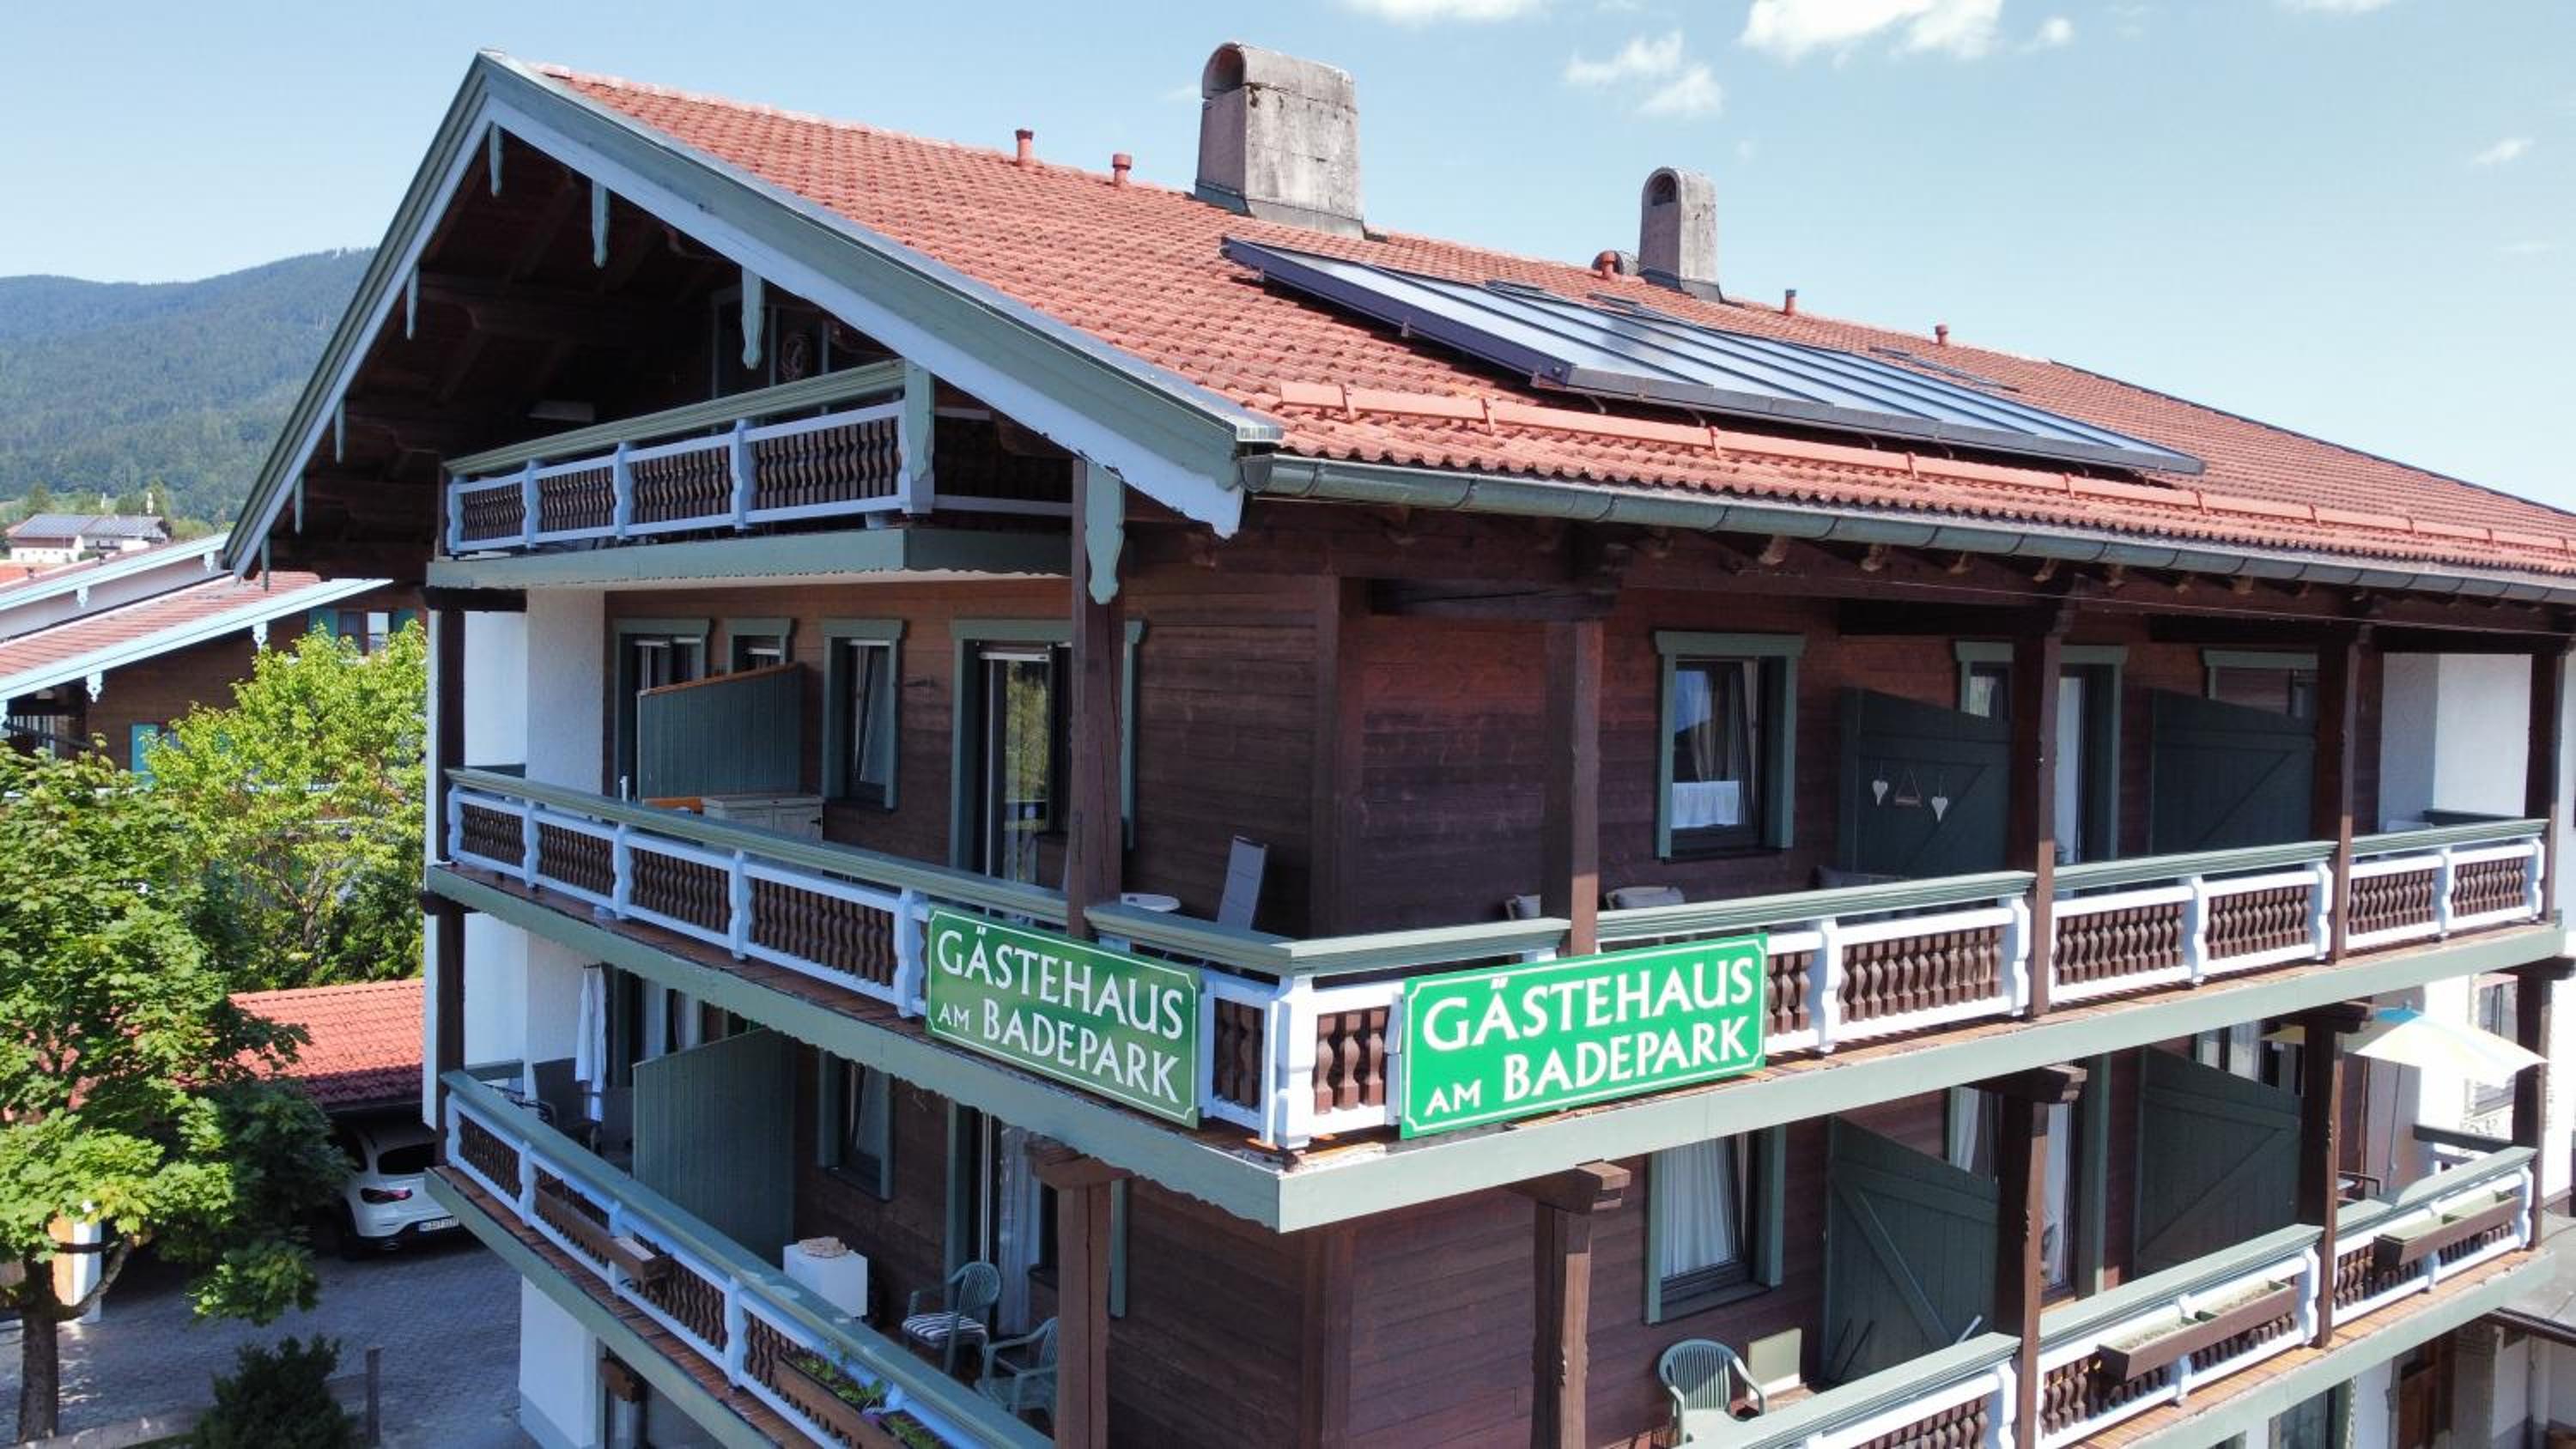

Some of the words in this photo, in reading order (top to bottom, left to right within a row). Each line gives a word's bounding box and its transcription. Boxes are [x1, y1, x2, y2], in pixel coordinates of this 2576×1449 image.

[937, 925, 1184, 1041] GÄSTEHAUS
[1422, 956, 1754, 1052] GÄSTEHAUS
[938, 1002, 971, 1033] AM
[983, 997, 1181, 1104] BADEPARK
[1425, 1079, 1482, 1117] AM
[1503, 1016, 1750, 1103] BADEPARK
